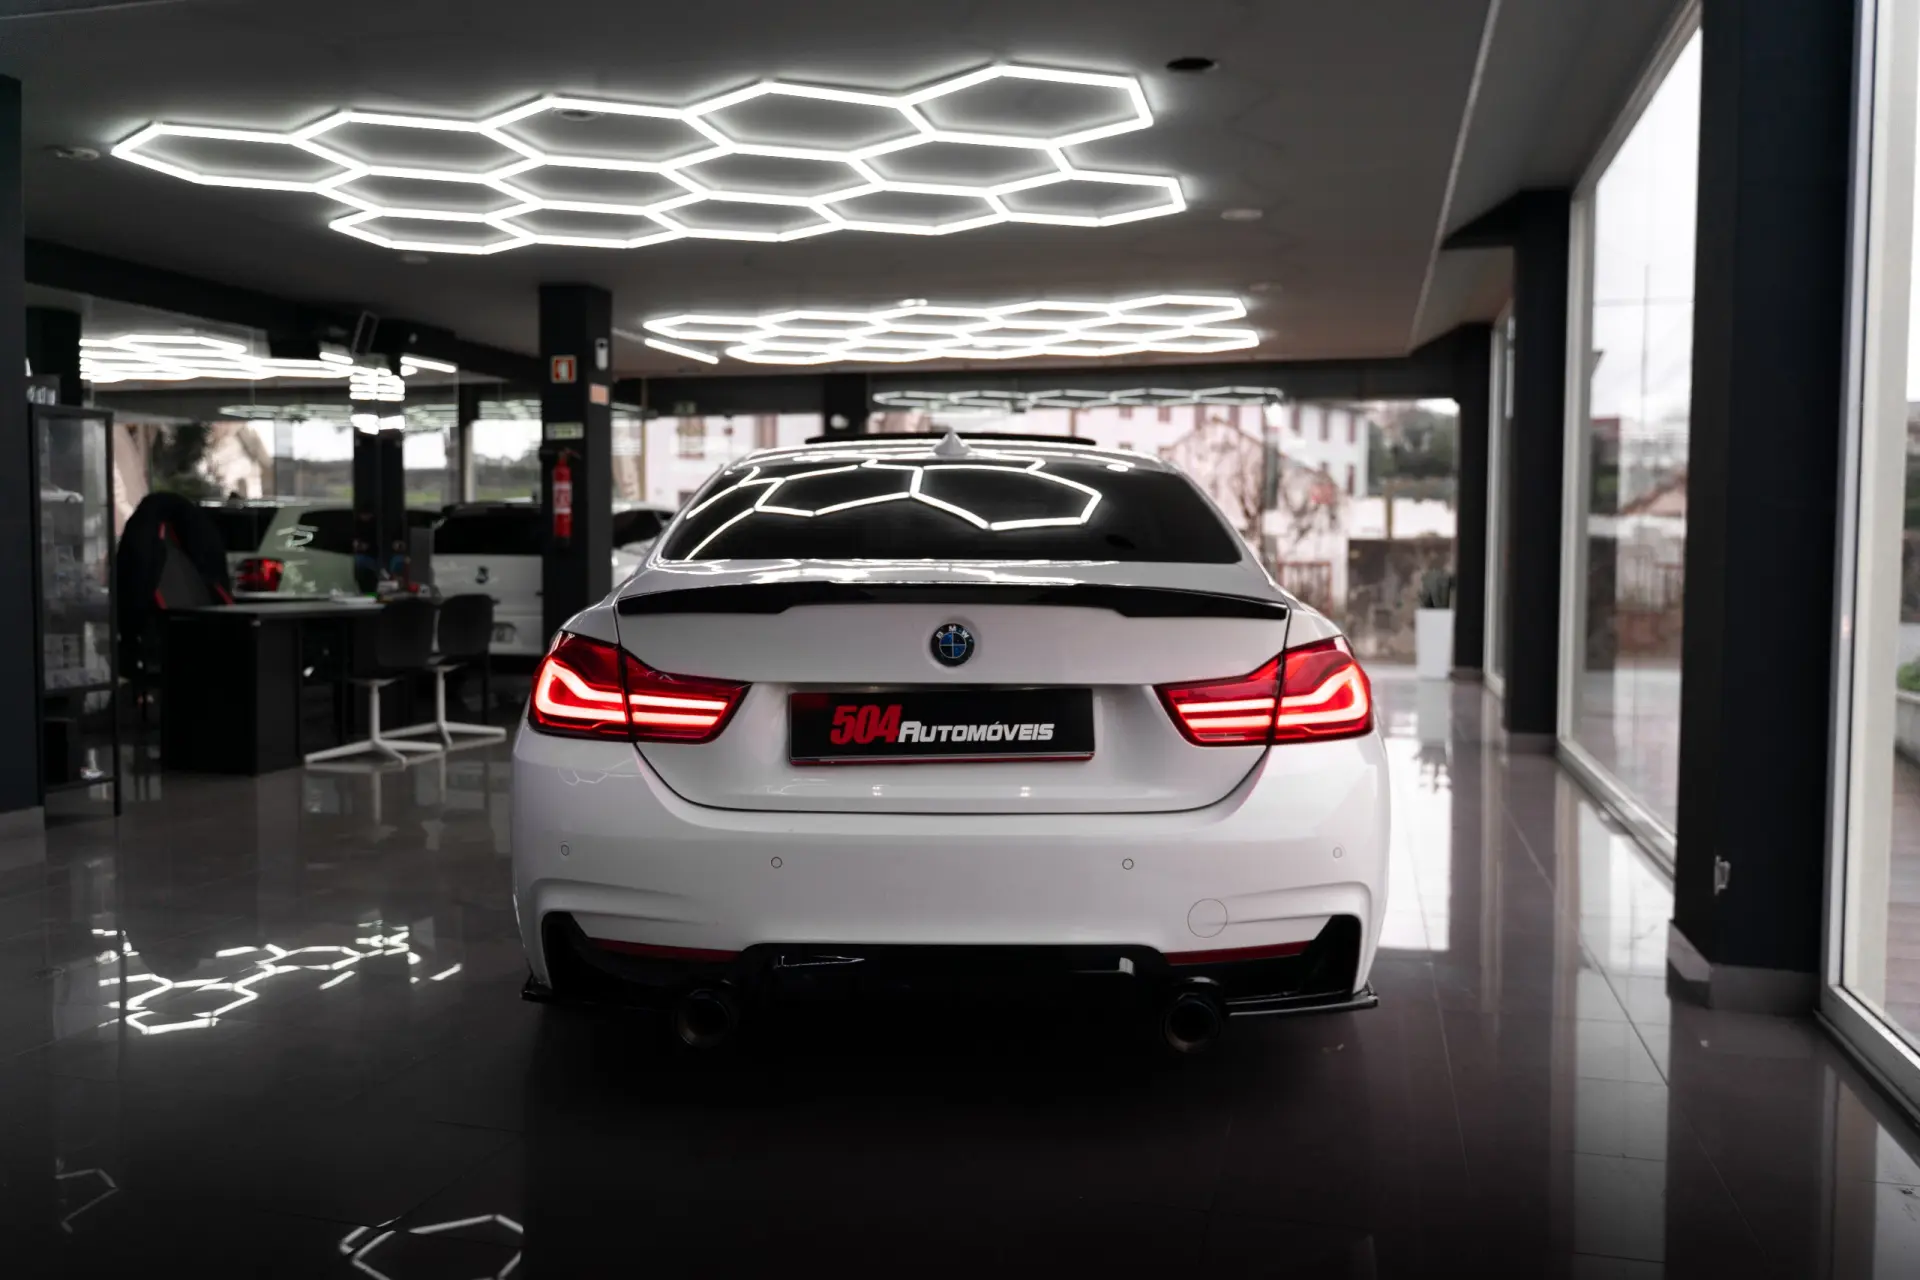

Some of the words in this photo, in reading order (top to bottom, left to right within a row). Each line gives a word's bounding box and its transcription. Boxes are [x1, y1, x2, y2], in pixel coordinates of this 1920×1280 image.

[936, 625, 969, 639] BMW
[830, 704, 902, 744] 504
[898, 721, 1055, 742] AUTOMÓVEIS
